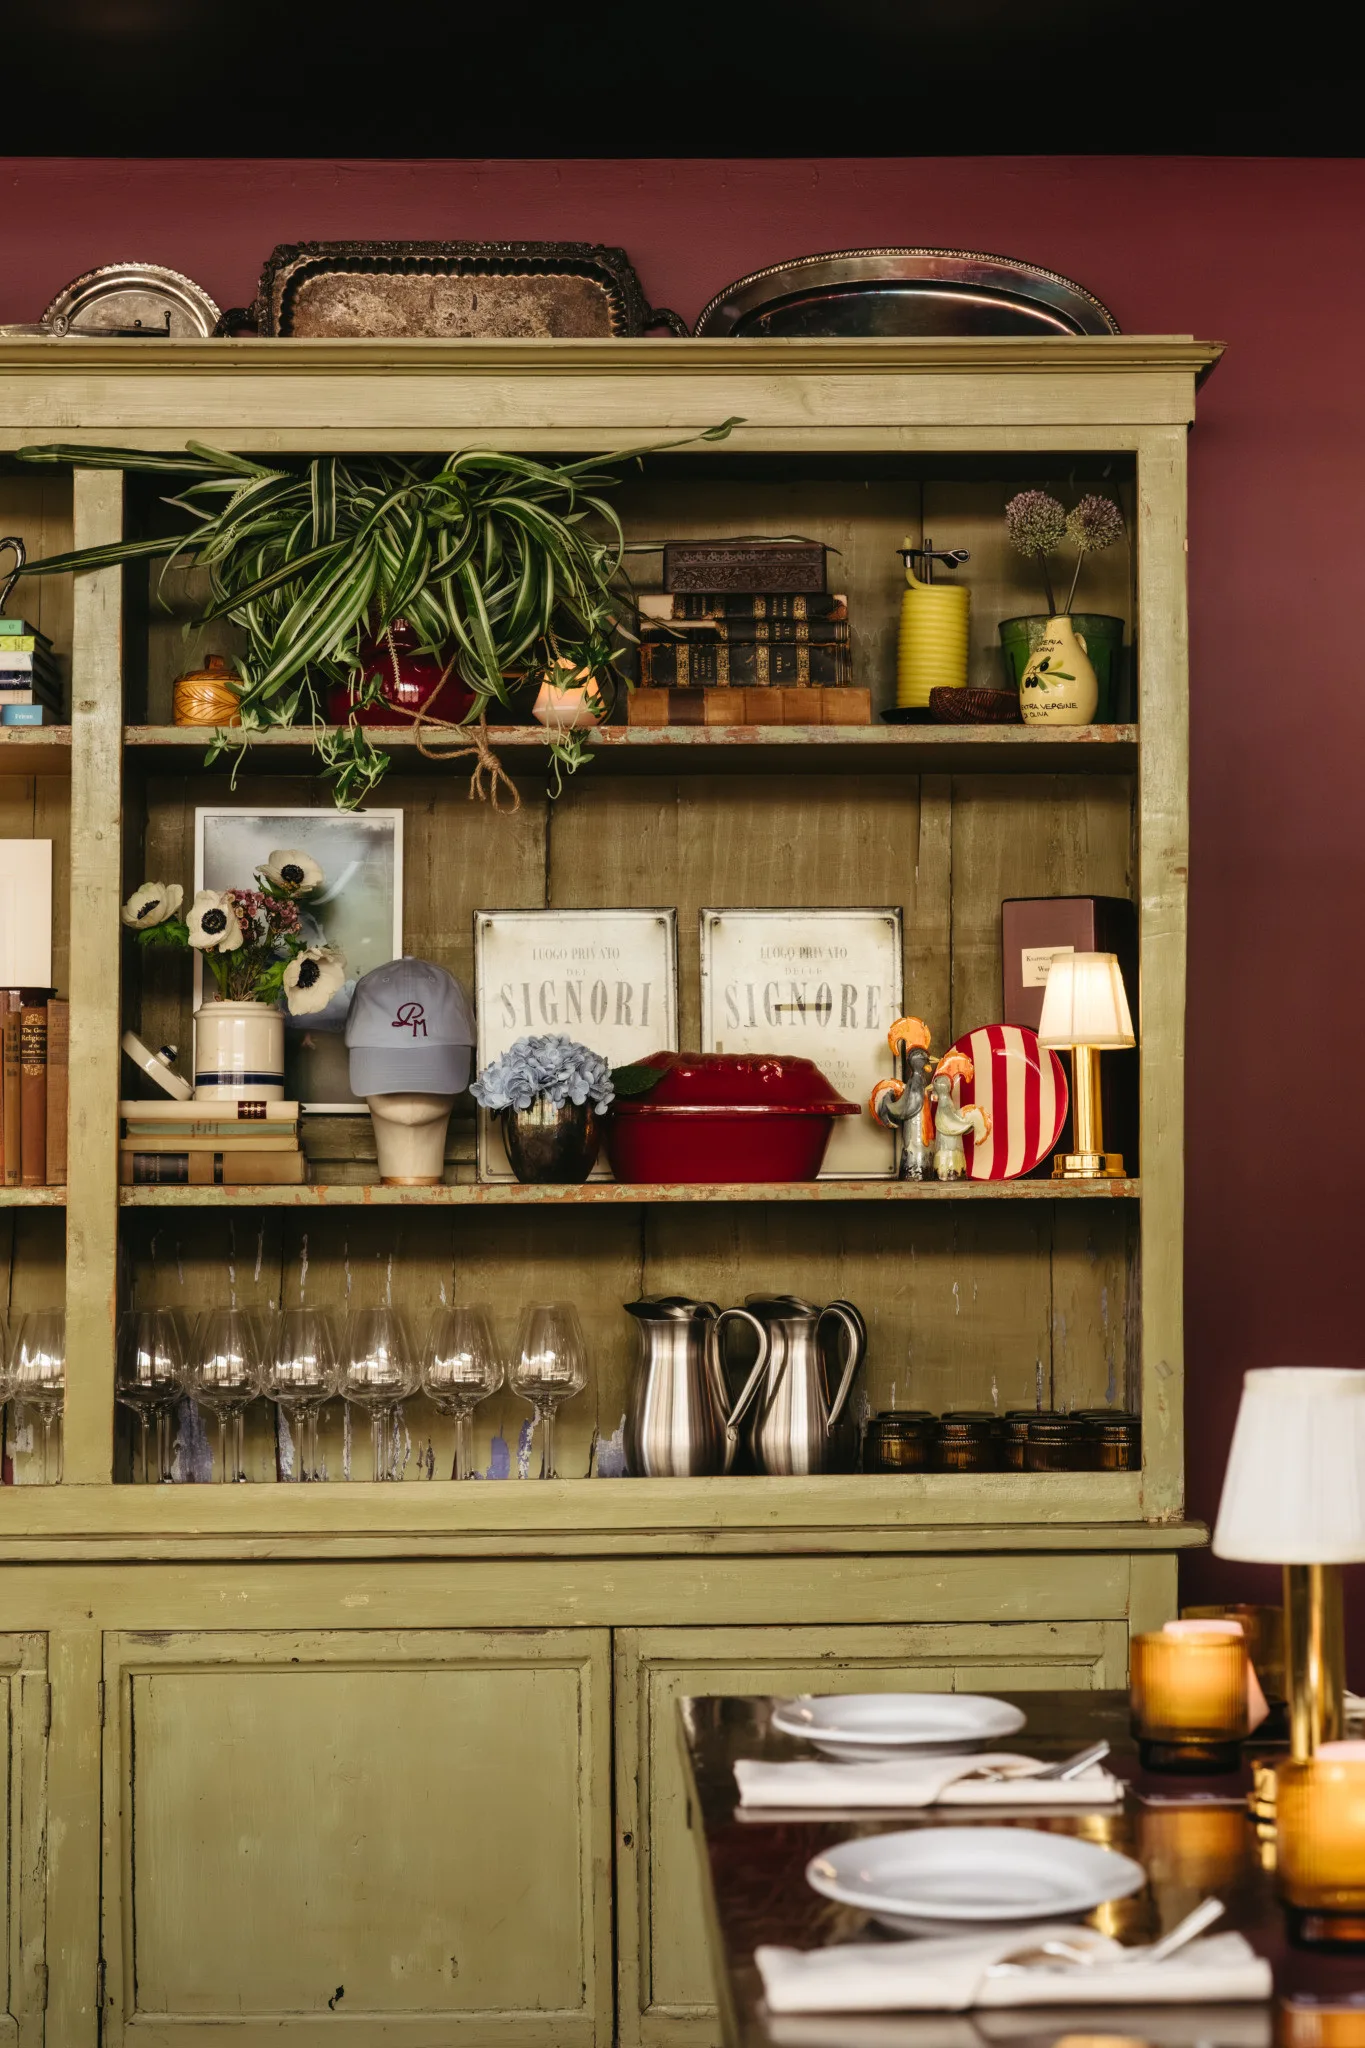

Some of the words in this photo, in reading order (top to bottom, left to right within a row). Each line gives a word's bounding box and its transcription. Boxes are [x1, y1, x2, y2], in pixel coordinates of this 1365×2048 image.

[571, 946, 620, 960] PRIVATO
[500, 979, 652, 1029] SIGNORI
[724, 981, 881, 1030] SIGNORE
